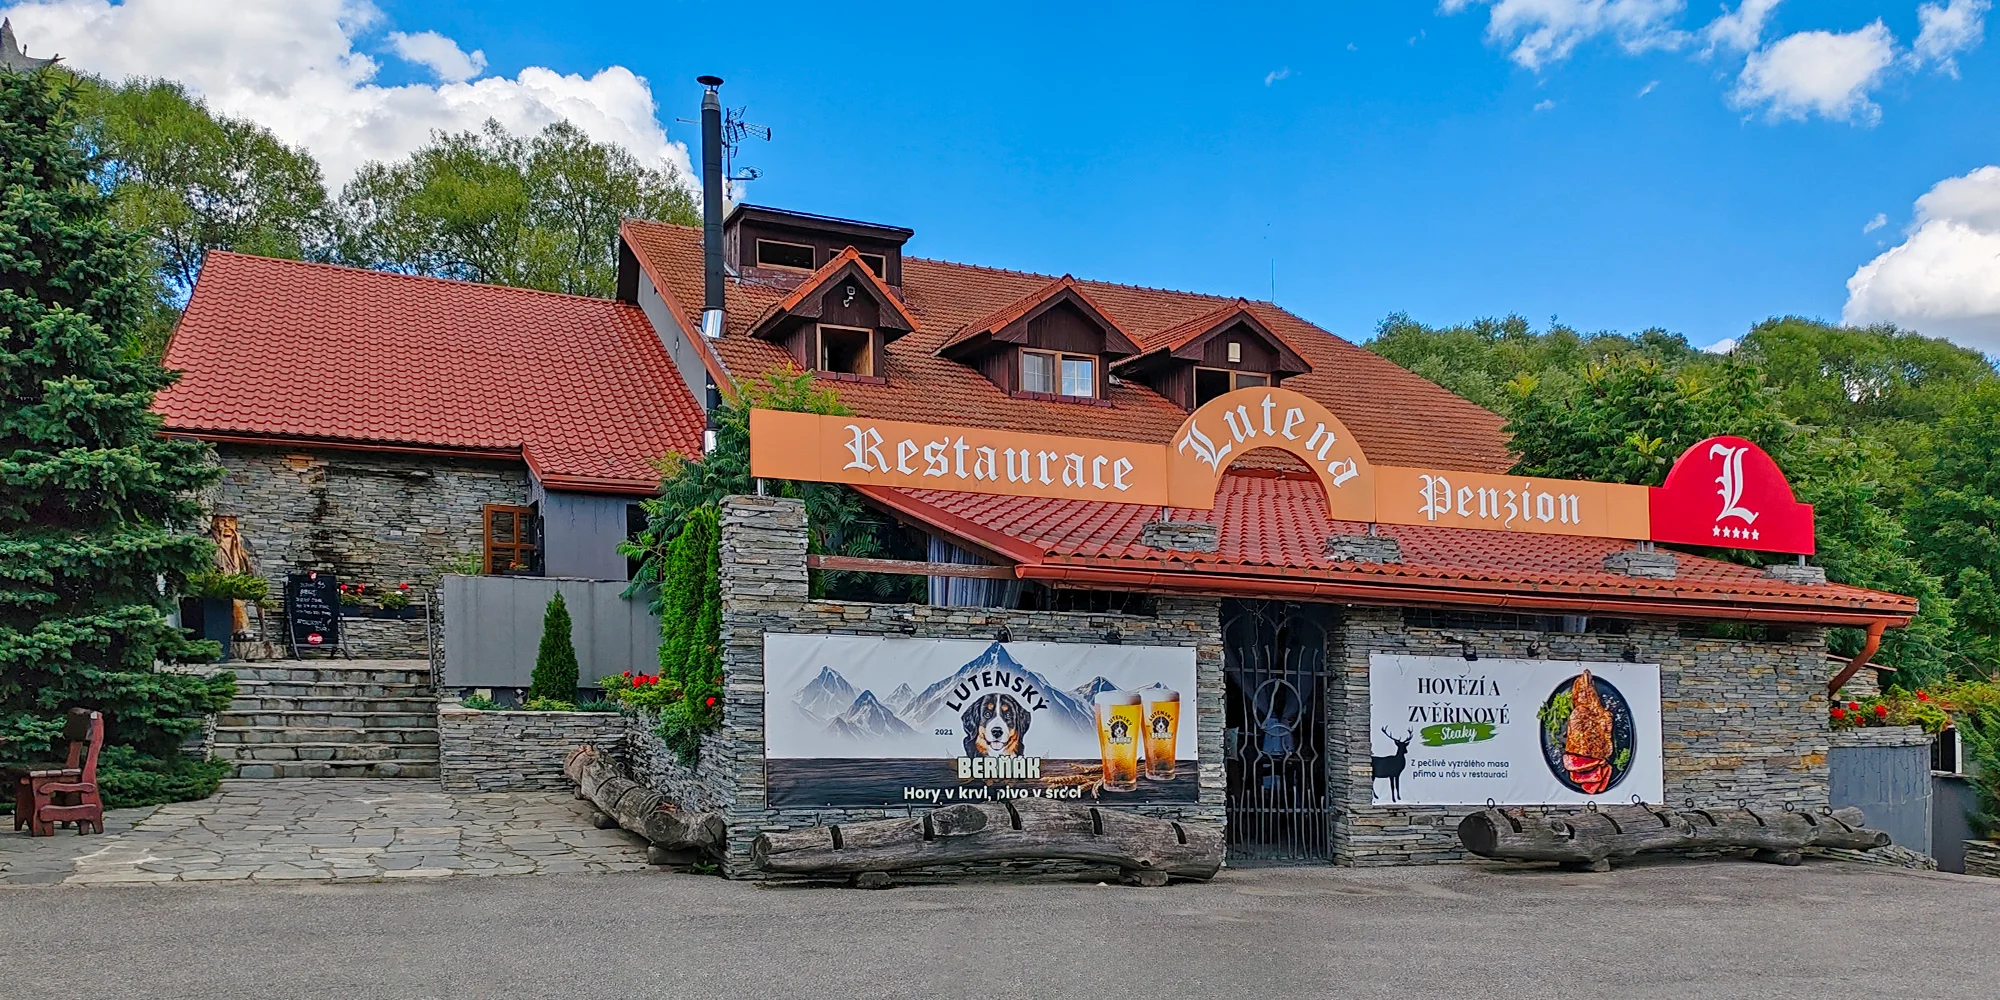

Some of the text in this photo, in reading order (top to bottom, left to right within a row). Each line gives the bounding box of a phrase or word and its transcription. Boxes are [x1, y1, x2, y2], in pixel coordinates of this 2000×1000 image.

[842, 393, 1582, 529] Restaurace Lutena Penzion
[1709, 443, 1759, 525] L
[946, 670, 1050, 713] LUTENSKÝ
[1417, 674, 1500, 696] HOVĚZÍ A
[1408, 701, 1510, 724] ZVĚŘINOVÉ
[934, 728, 954, 736] 2021
[1440, 725, 1477, 742] Steaky
[957, 755, 1041, 779] BERŇÁK
[1412, 769, 1437, 779] přímo
[1445, 769, 1460, 778] nás
[1469, 770, 1508, 778] restauraci
[1417, 758, 1446, 769] pečlivě
[1447, 759, 1486, 769] vyzrálého
[1487, 760, 1510, 768] masa
[903, 786, 941, 803] Hory
[942, 788, 954, 799] v
[959, 785, 992, 801] krvi,
[1031, 788, 1042, 798] v
